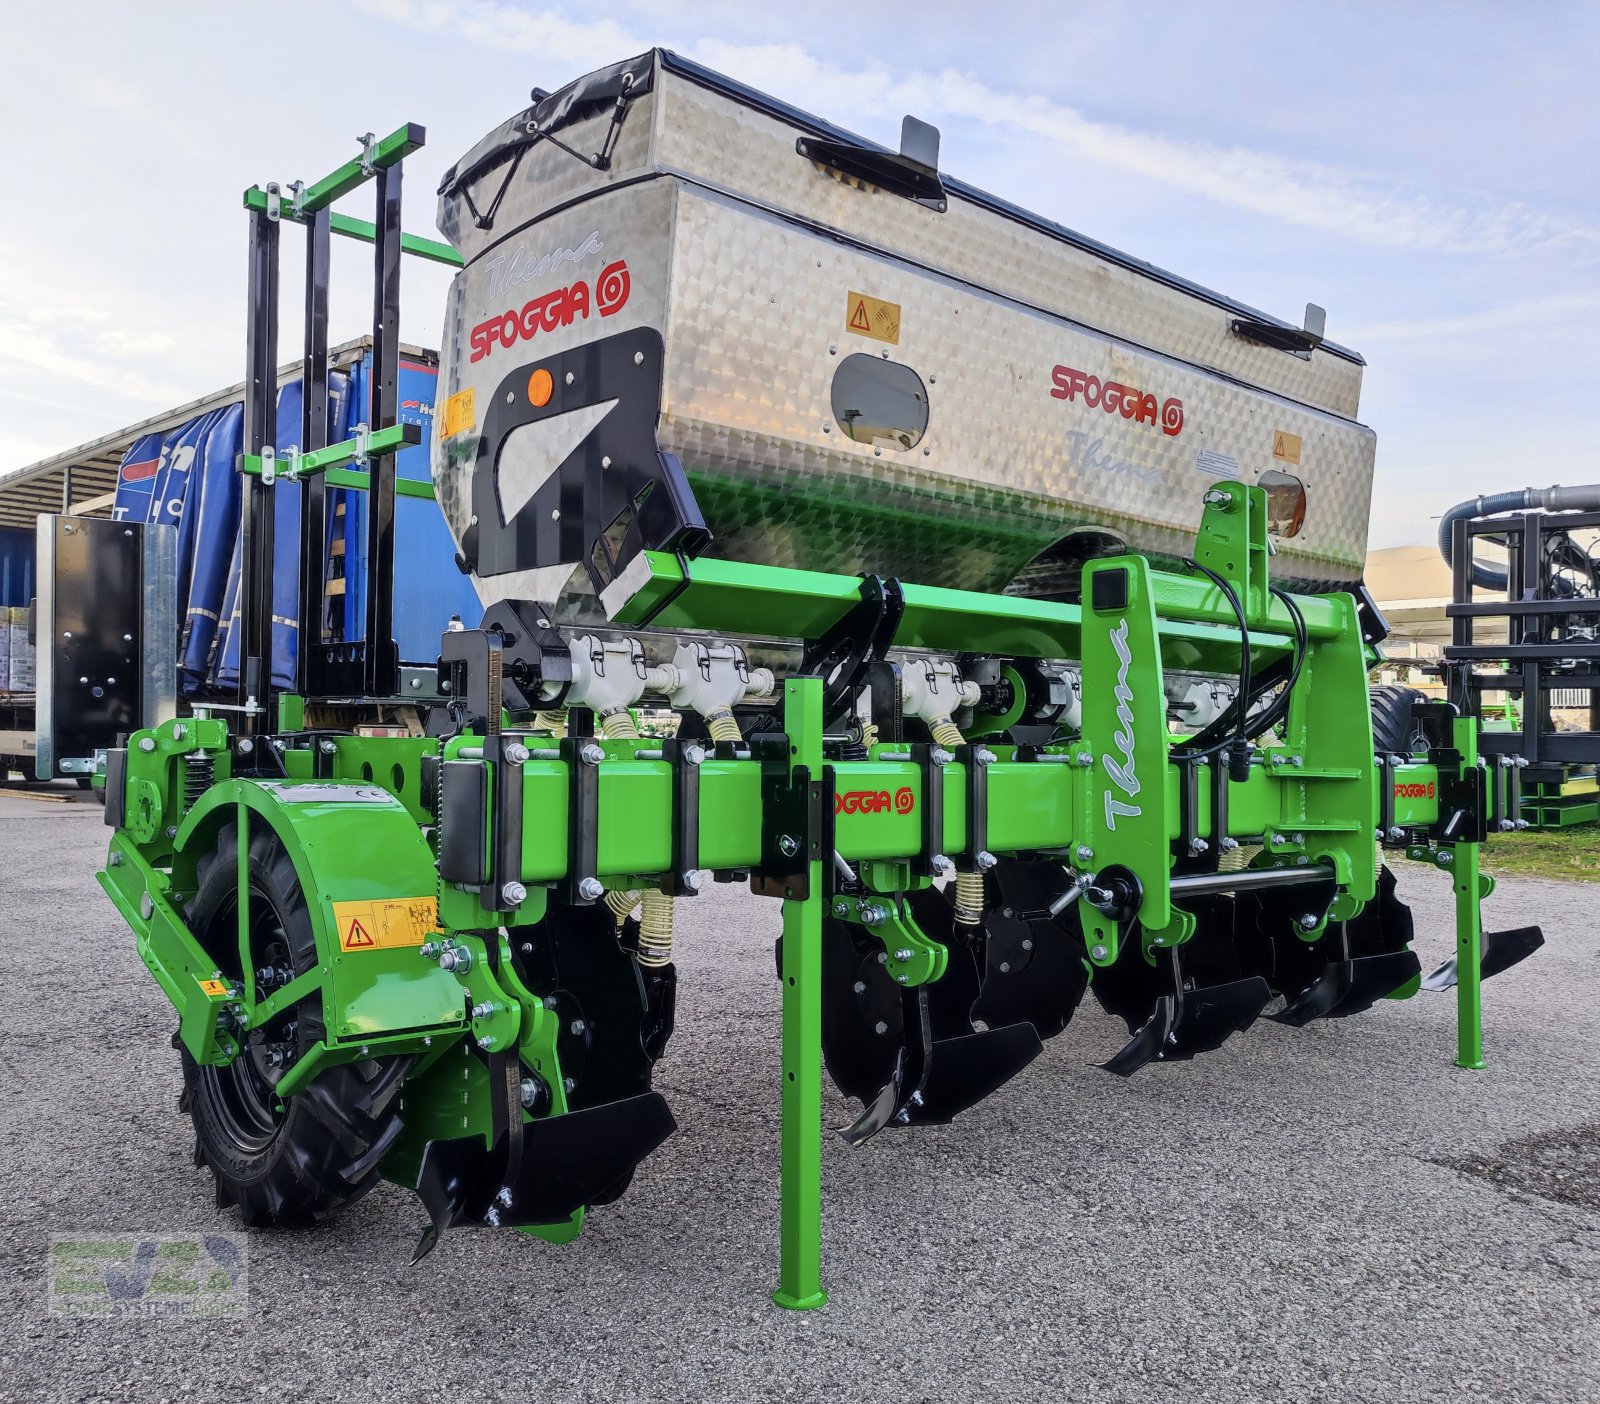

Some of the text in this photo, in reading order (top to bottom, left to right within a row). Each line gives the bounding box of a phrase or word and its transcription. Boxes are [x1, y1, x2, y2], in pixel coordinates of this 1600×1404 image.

[486, 231, 604, 300] Thema
[470, 280, 589, 364] SFOGGIA
[1050, 365, 1159, 427] SFOGGIA
[1066, 430, 1163, 486] Thema
[1102, 617, 1142, 832] Thema
[834, 791, 892, 815] OGGIA
